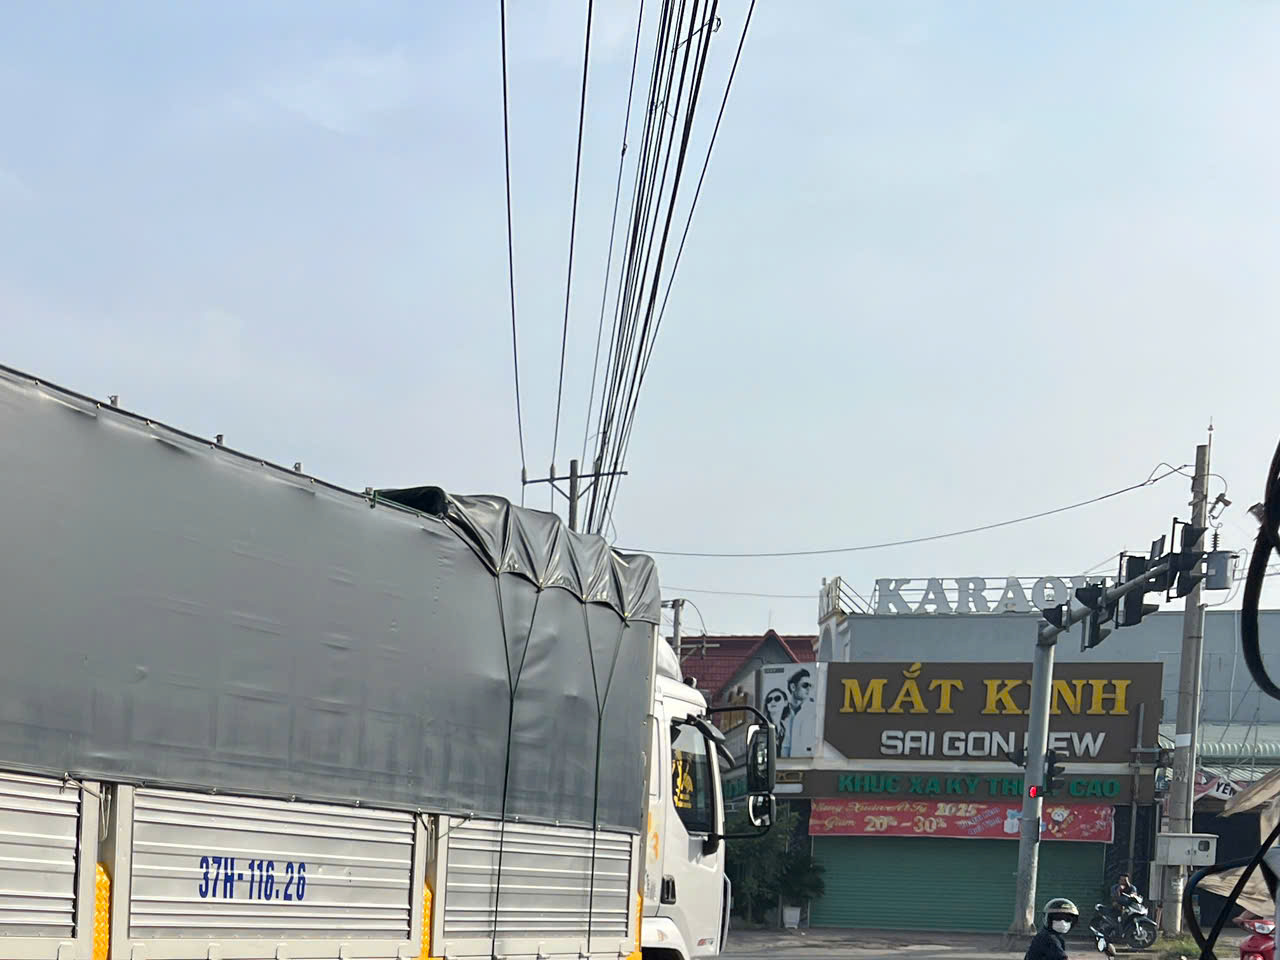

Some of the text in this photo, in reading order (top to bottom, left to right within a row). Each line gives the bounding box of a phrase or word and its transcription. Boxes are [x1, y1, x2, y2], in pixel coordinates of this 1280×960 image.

[874, 576, 1118, 615] KARAO
[839, 662, 964, 714] MẮT
[880, 730, 1106, 757] SAI GON EW
[1070, 779, 1120, 797] CAO
[198, 855, 306, 901] 37H-116.26
